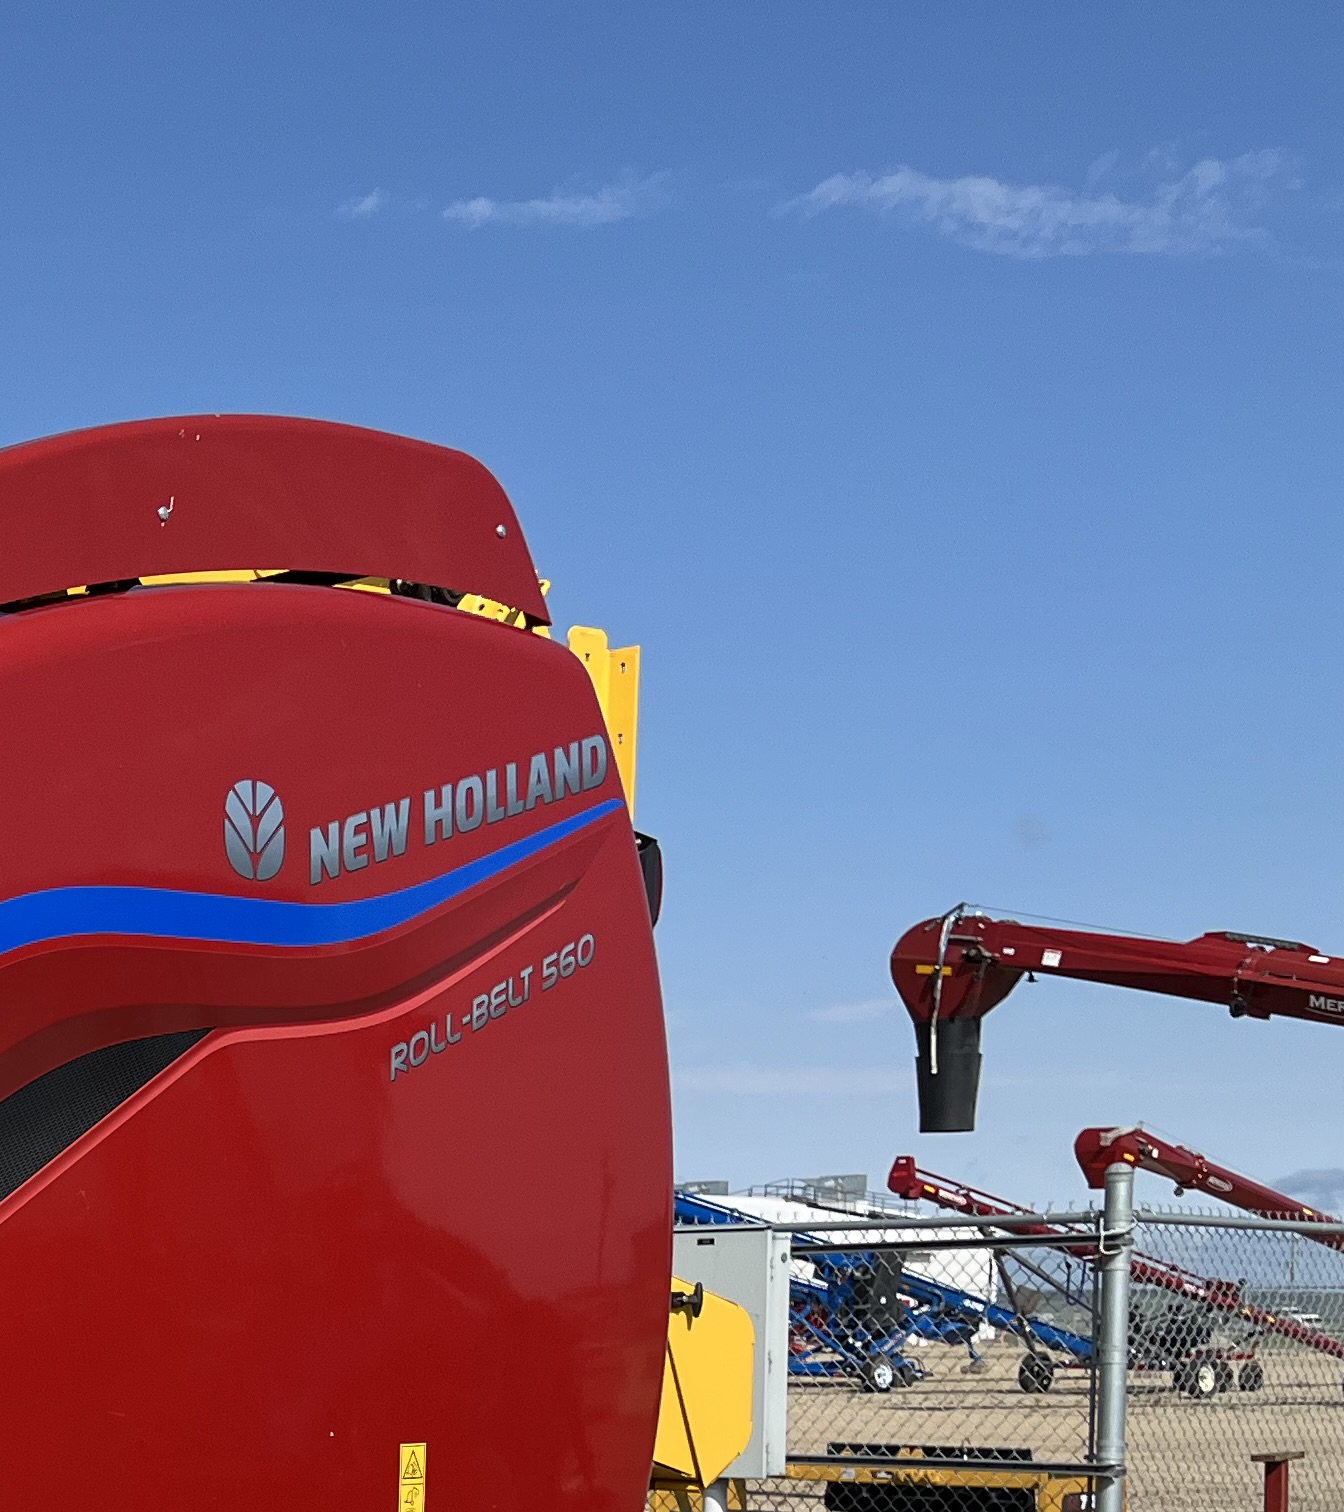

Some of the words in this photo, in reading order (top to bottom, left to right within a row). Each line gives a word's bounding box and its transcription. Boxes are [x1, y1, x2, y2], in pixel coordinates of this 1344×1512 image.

[309, 797, 410, 885] NEW
[423, 734, 608, 846] HOLLAND
[390, 965, 534, 1081] ROLL-BELT
[541, 932, 595, 992] 560
